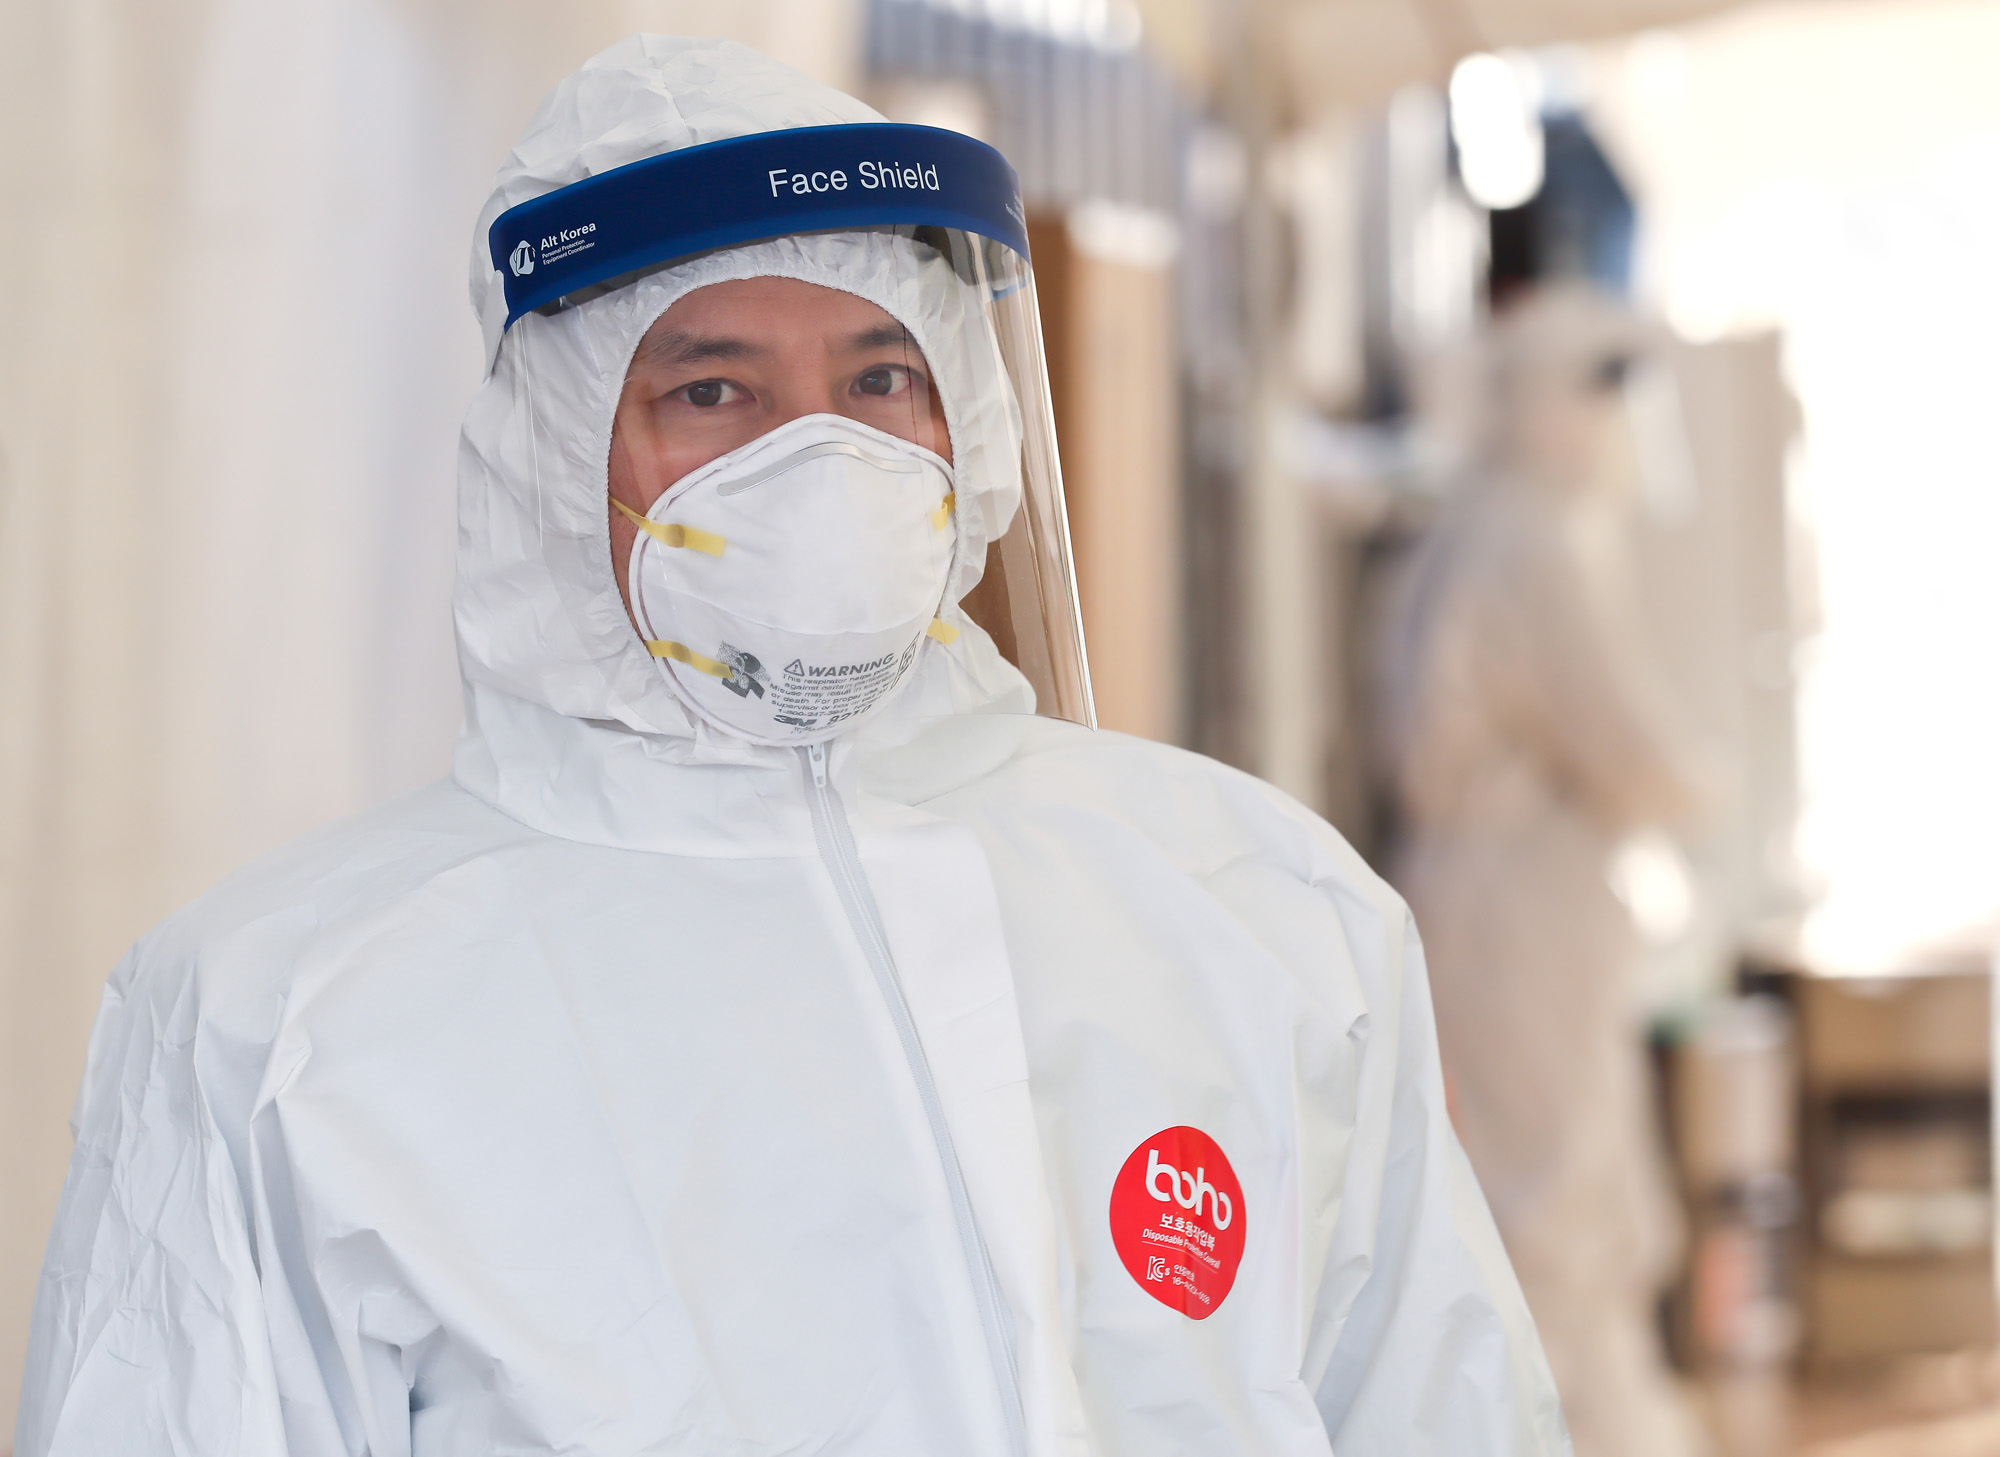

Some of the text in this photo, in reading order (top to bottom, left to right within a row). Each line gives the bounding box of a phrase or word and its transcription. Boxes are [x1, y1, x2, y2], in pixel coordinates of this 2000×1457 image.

[768, 161, 940, 198] Face Shield
[540, 222, 597, 251] Alt Korea
[541, 239, 585, 259] Personal Protection
[542, 242, 595, 266] Equipment Coordinator
[808, 652, 894, 677] WARNING
[782, 673, 801, 683] This
[784, 682, 819, 690] against
[769, 683, 802, 697] Misuse
[833, 694, 861, 704] proper
[771, 700, 819, 711] supervisor
[773, 715, 817, 727] 3M
[1145, 1148, 1233, 1231] boho
[1142, 1228, 1183, 1247] Disposable
